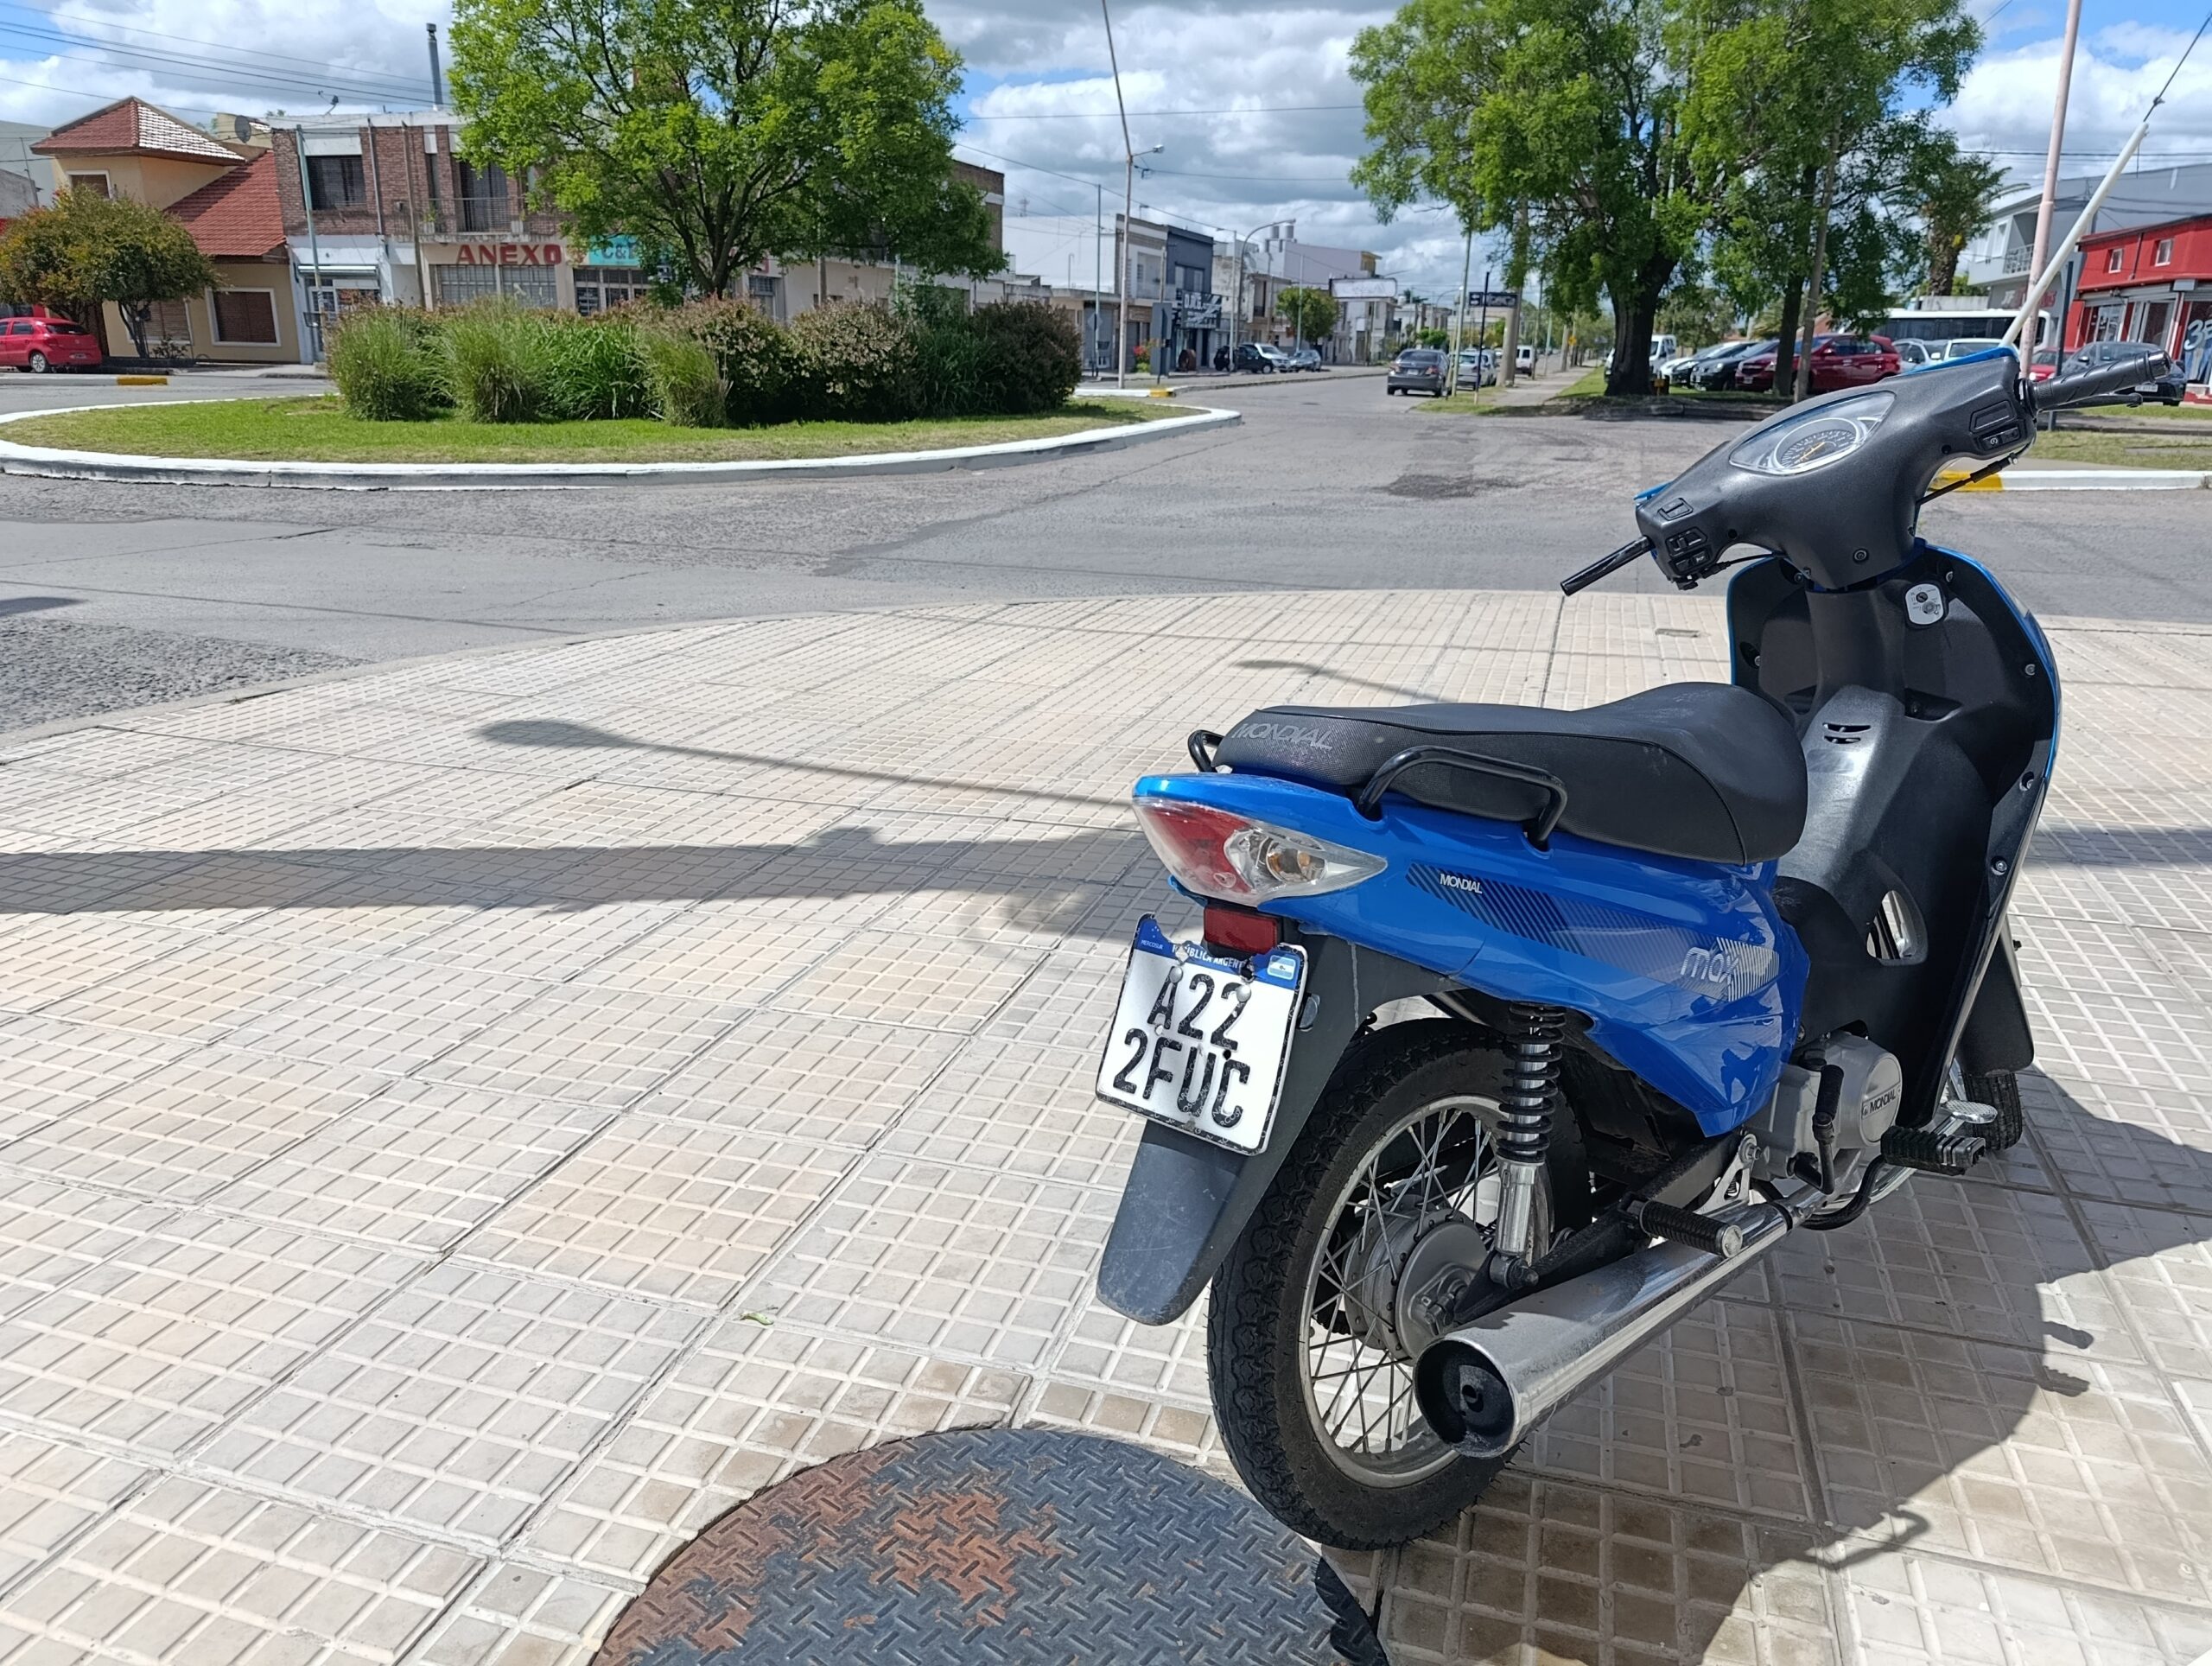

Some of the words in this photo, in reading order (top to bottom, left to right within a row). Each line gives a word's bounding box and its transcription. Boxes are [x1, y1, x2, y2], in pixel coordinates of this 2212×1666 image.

[457, 244, 562, 265] ANEXO
[1231, 723, 1332, 750] MONDIAL
[1440, 873, 1483, 894] MONDIAL
[1147, 966, 1251, 1051] A22
[1113, 1028, 1250, 1129] 2FUC
[1870, 1089, 1896, 1113] MONDIAL
